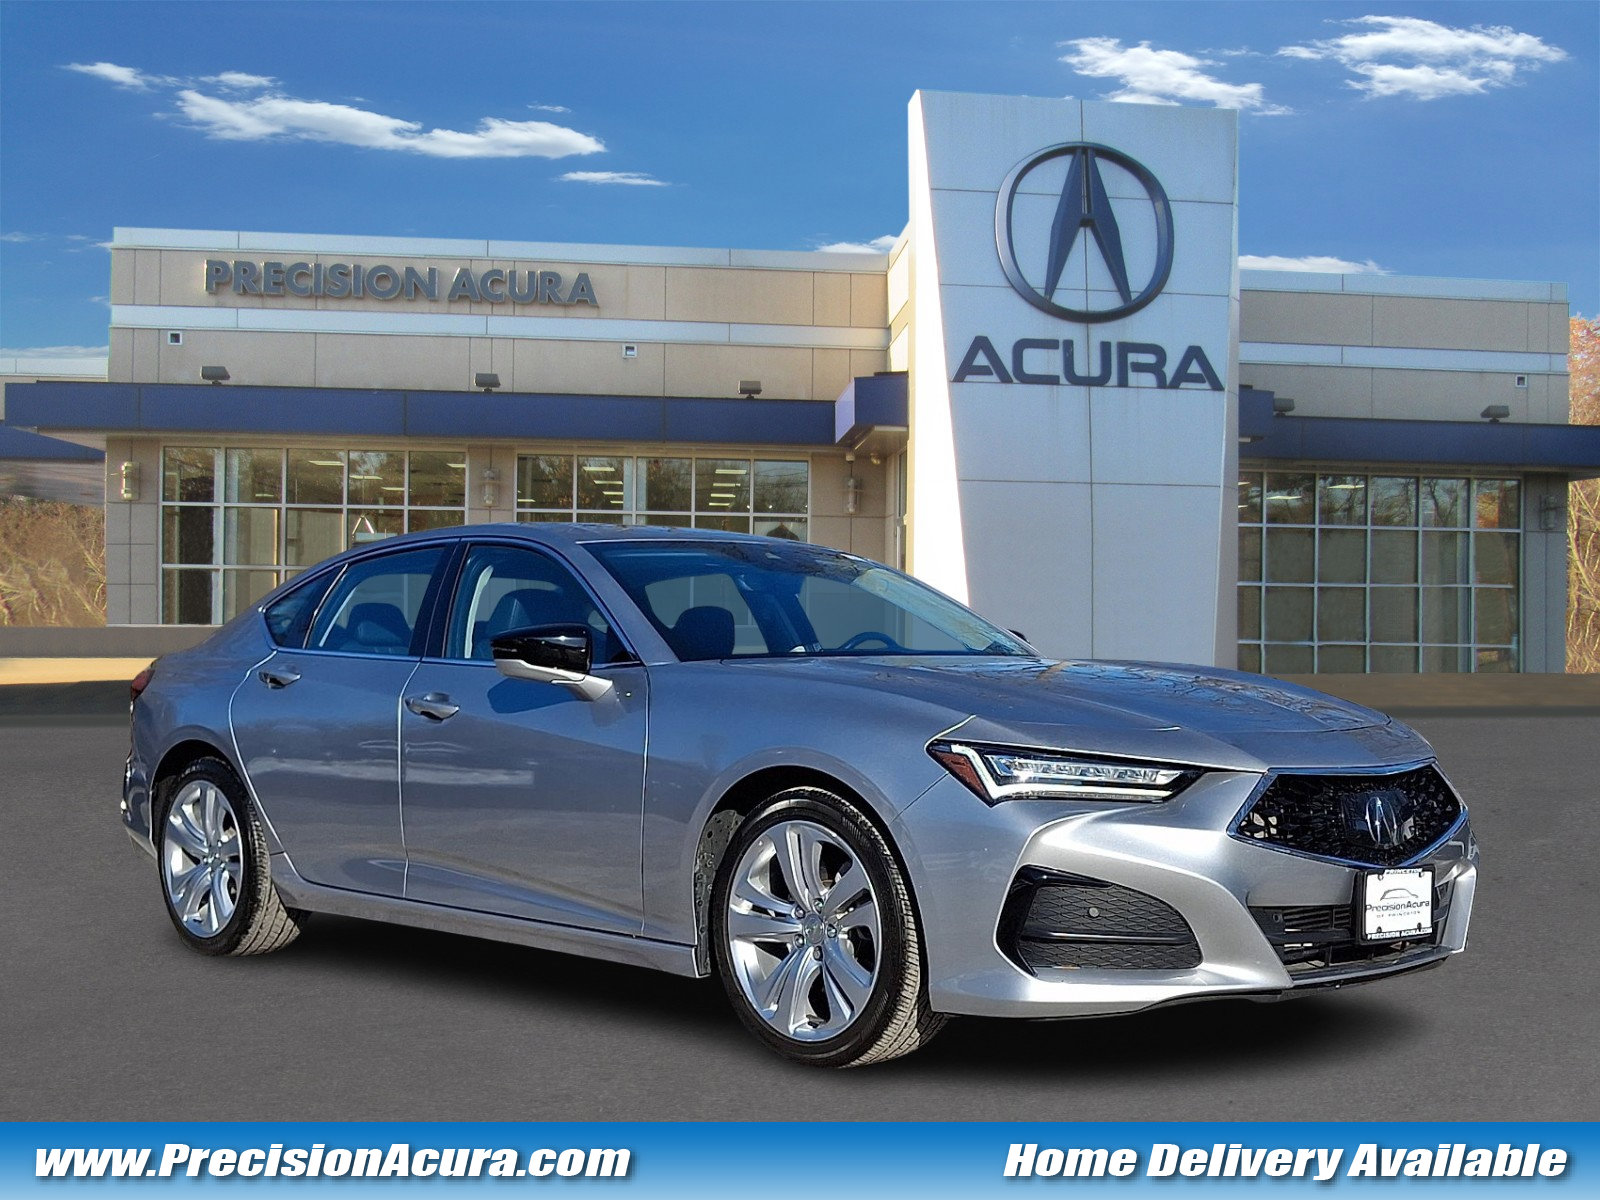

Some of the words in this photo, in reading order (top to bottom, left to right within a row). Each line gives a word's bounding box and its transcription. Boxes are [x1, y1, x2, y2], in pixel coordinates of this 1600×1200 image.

[204, 259, 438, 300] PRECISION
[447, 267, 600, 307] ACURA
[951, 335, 1225, 391] ACURA
[1366, 901, 1430, 911] PrecisionAcura
